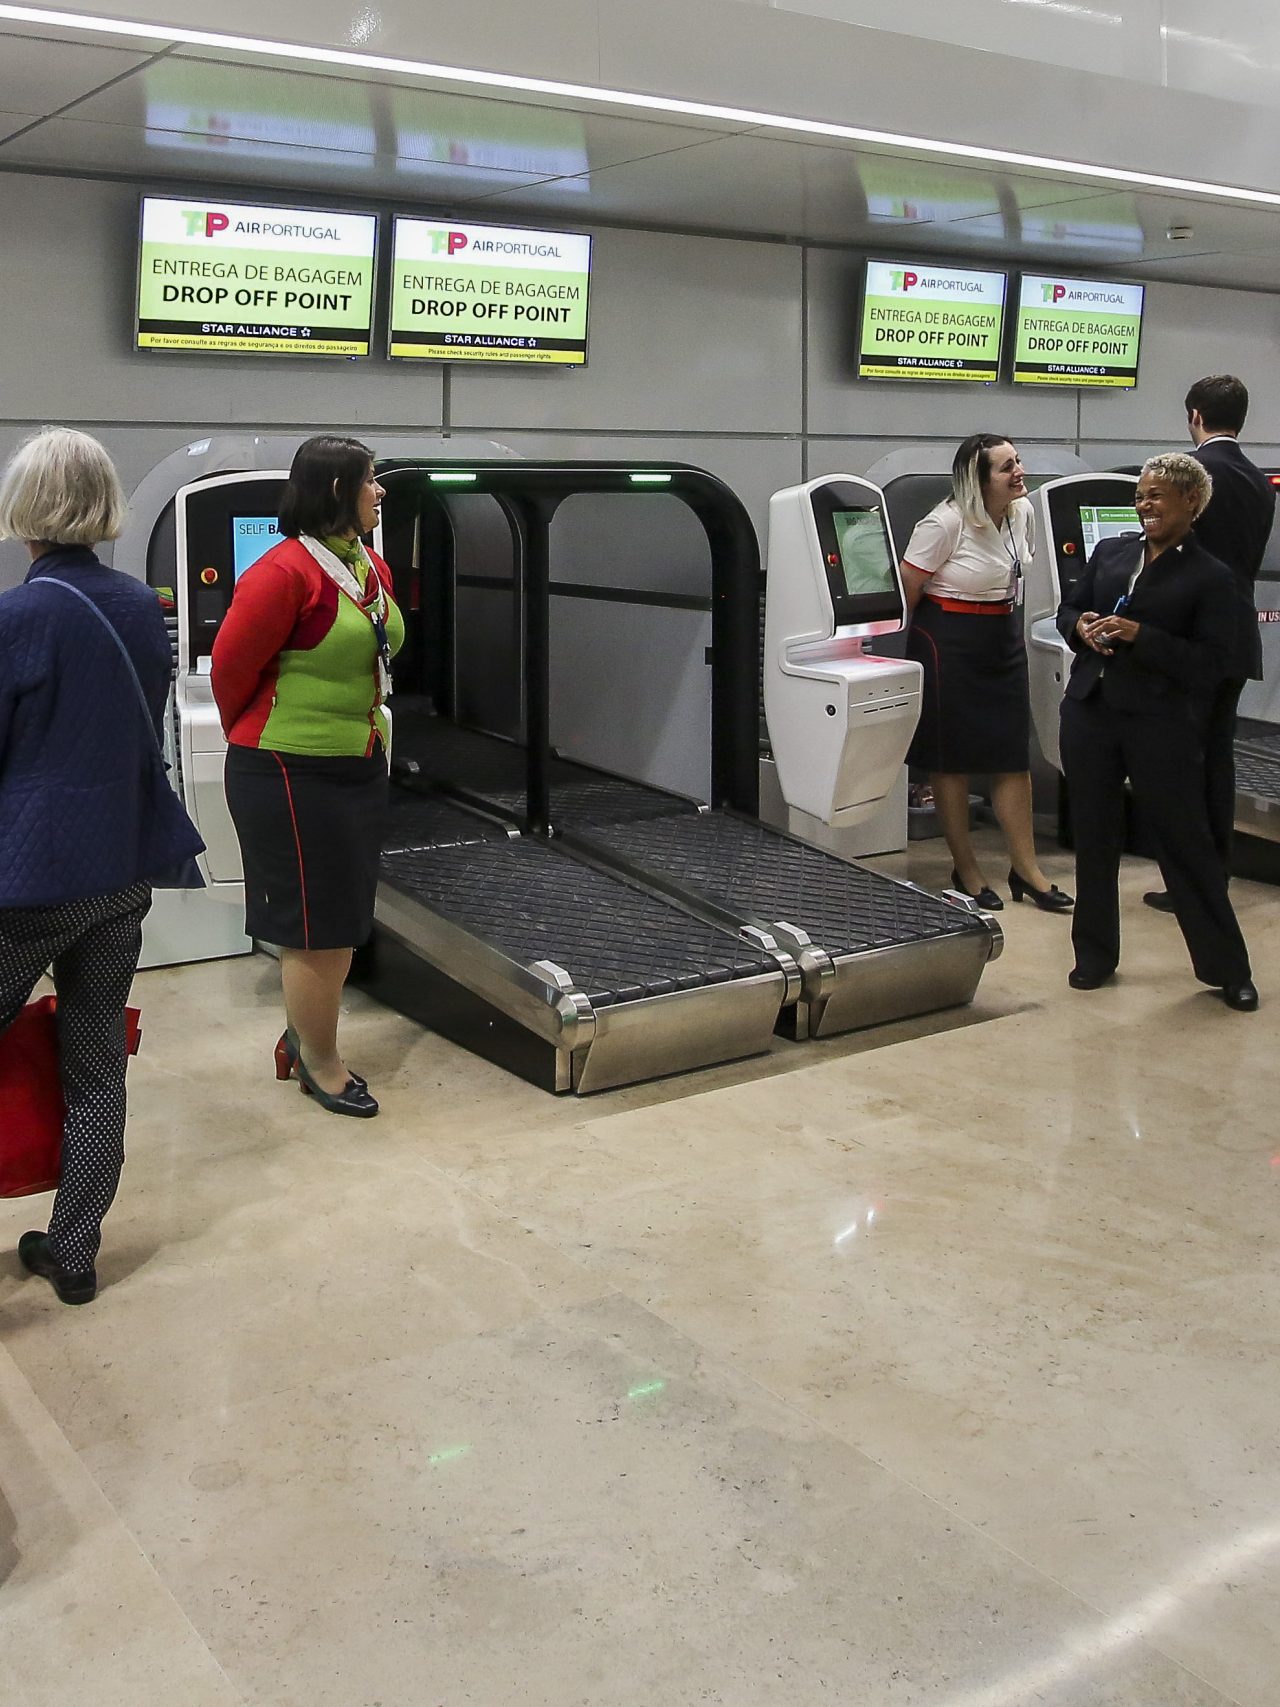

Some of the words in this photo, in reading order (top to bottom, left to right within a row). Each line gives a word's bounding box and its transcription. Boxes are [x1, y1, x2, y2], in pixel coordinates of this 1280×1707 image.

[153, 259, 238, 278] ENTREGA
[245, 264, 268, 280] DE
[274, 266, 362, 286] BAGAGEM
[403, 275, 475, 293] ENTREGA
[481, 280, 500, 295] DE
[505, 282, 579, 300] BAGAGEM
[163, 285, 228, 304] DROP
[235, 289, 278, 307] OFF
[285, 292, 352, 311] POINT
[411, 299, 467, 317] DROP
[472, 302, 509, 319] OFF
[514, 305, 571, 323] POINT
[871, 308, 922, 323] ENTREGA
[925, 312, 939, 325] DE
[942, 313, 996, 328] BAGAGEM
[202, 323, 234, 333] STAR
[237, 325, 297, 336] ALLIANCE
[1024, 318, 1069, 333] ENTREGA
[1072, 322, 1085, 334] DE
[1087, 323, 1135, 337] BAGAGEM
[444, 334, 471, 344] STAR
[474, 336, 524, 346] ALLIANCE
[875, 327, 915, 343] DROP
[919, 330, 944, 345] OFF
[948, 333, 989, 348] POINT
[1028, 337, 1063, 351] DROP
[1066, 339, 1089, 353] OFF
[1092, 341, 1128, 355] POINT
[897, 357, 917, 365] STAR
[918, 358, 954, 367] ALLIANCE
[1066, 366, 1098, 374] ALLIANCE
[239, 523, 265, 535] SELF
[1258, 612, 1267, 622] IN
[1268, 612, 1280, 622] US
